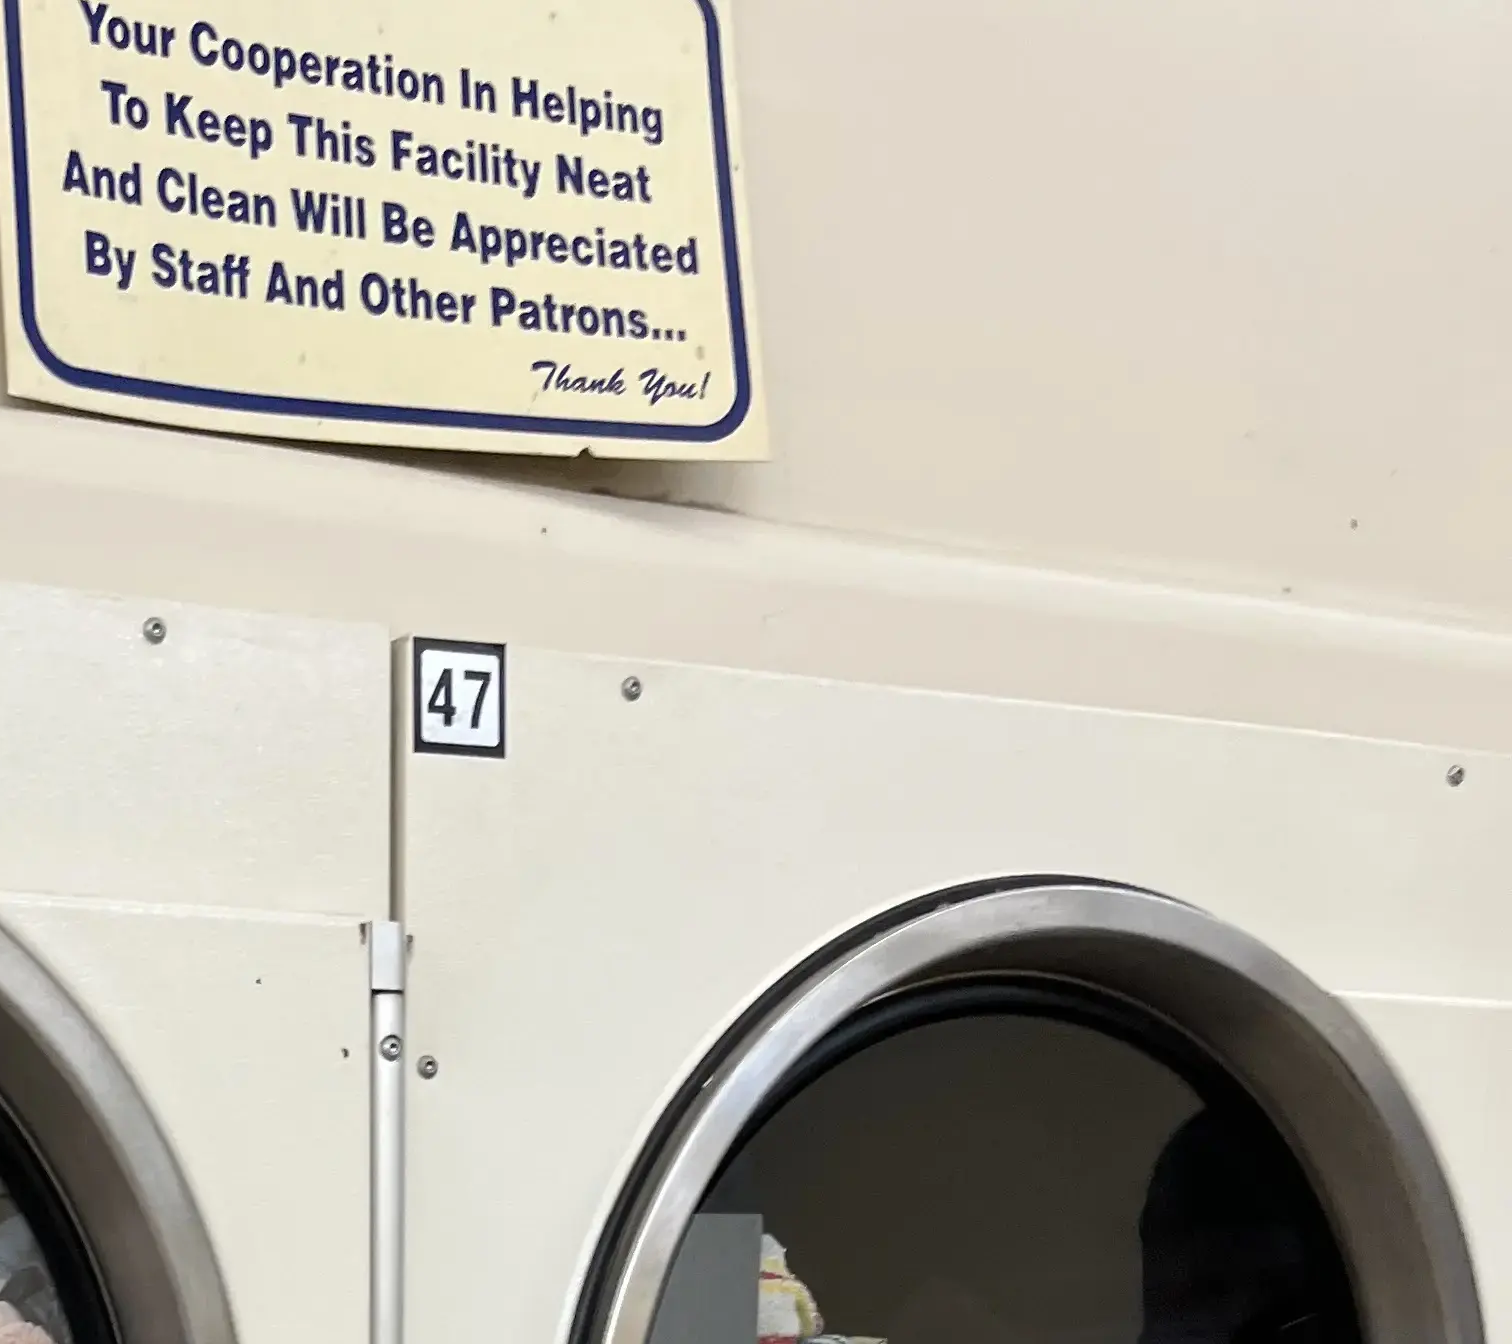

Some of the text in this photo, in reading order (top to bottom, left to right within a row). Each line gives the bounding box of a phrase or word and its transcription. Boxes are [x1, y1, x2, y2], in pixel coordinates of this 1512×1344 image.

[80, 0, 664, 145] Your Cooperation In Helping
[100, 80, 653, 203] To Keep This Facility Neat
[62, 149, 700, 275] And Clean Will Be Appreciated
[85, 229, 688, 342] By Staff And Other Patrons...
[530, 360, 712, 406] Thank You!
[427, 667, 492, 730] 47
